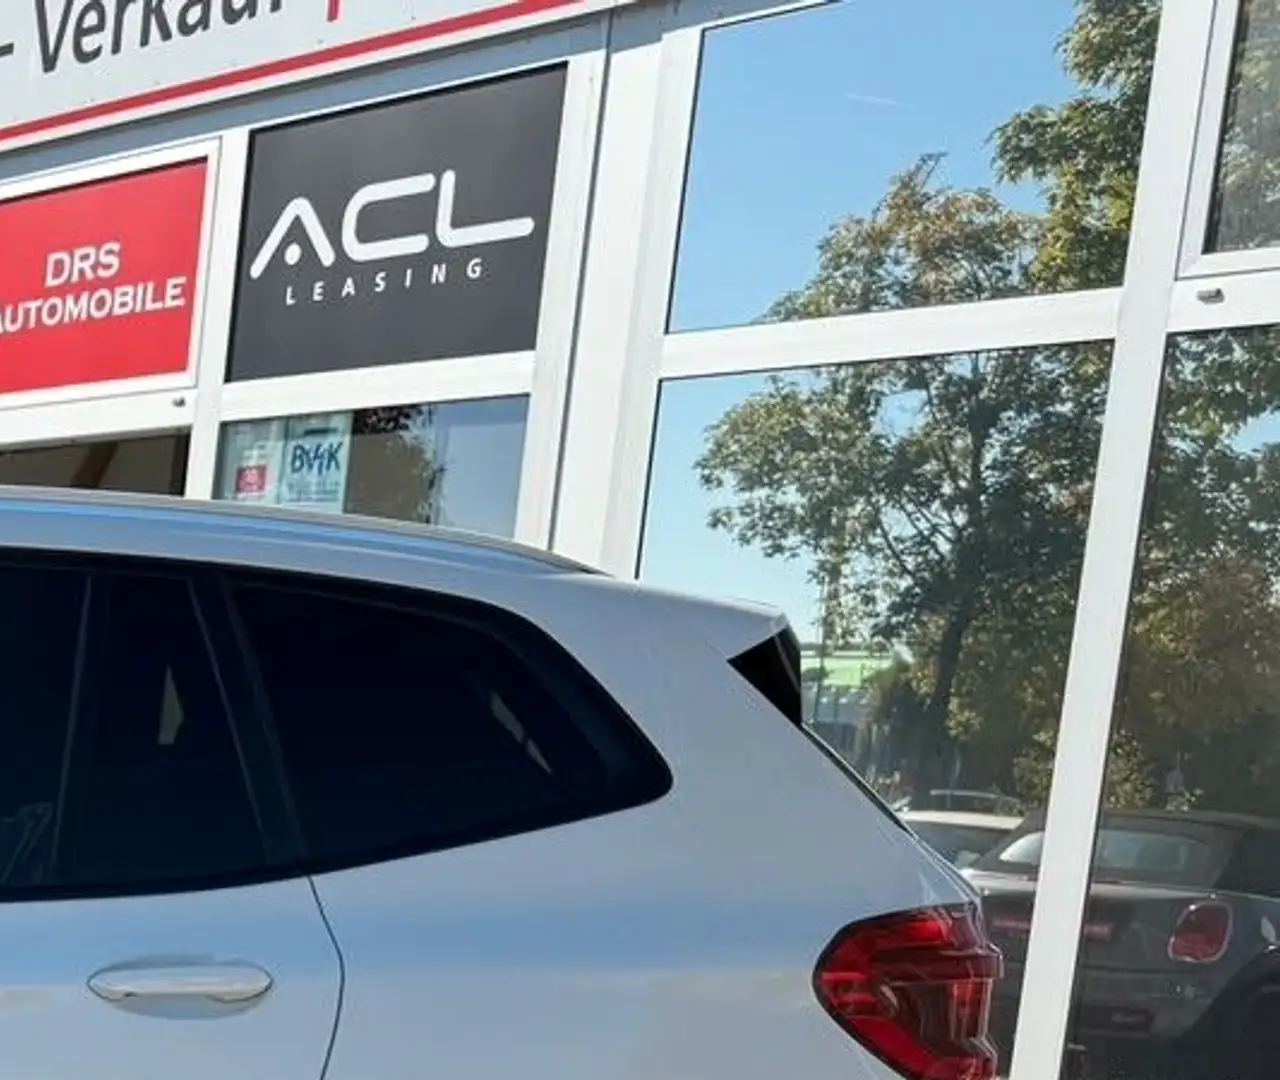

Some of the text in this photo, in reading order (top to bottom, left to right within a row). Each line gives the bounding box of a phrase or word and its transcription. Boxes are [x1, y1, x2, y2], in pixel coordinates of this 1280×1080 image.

[250, 169, 535, 279] ACL
[44, 242, 121, 288] DRS
[285, 257, 483, 306] LEASING
